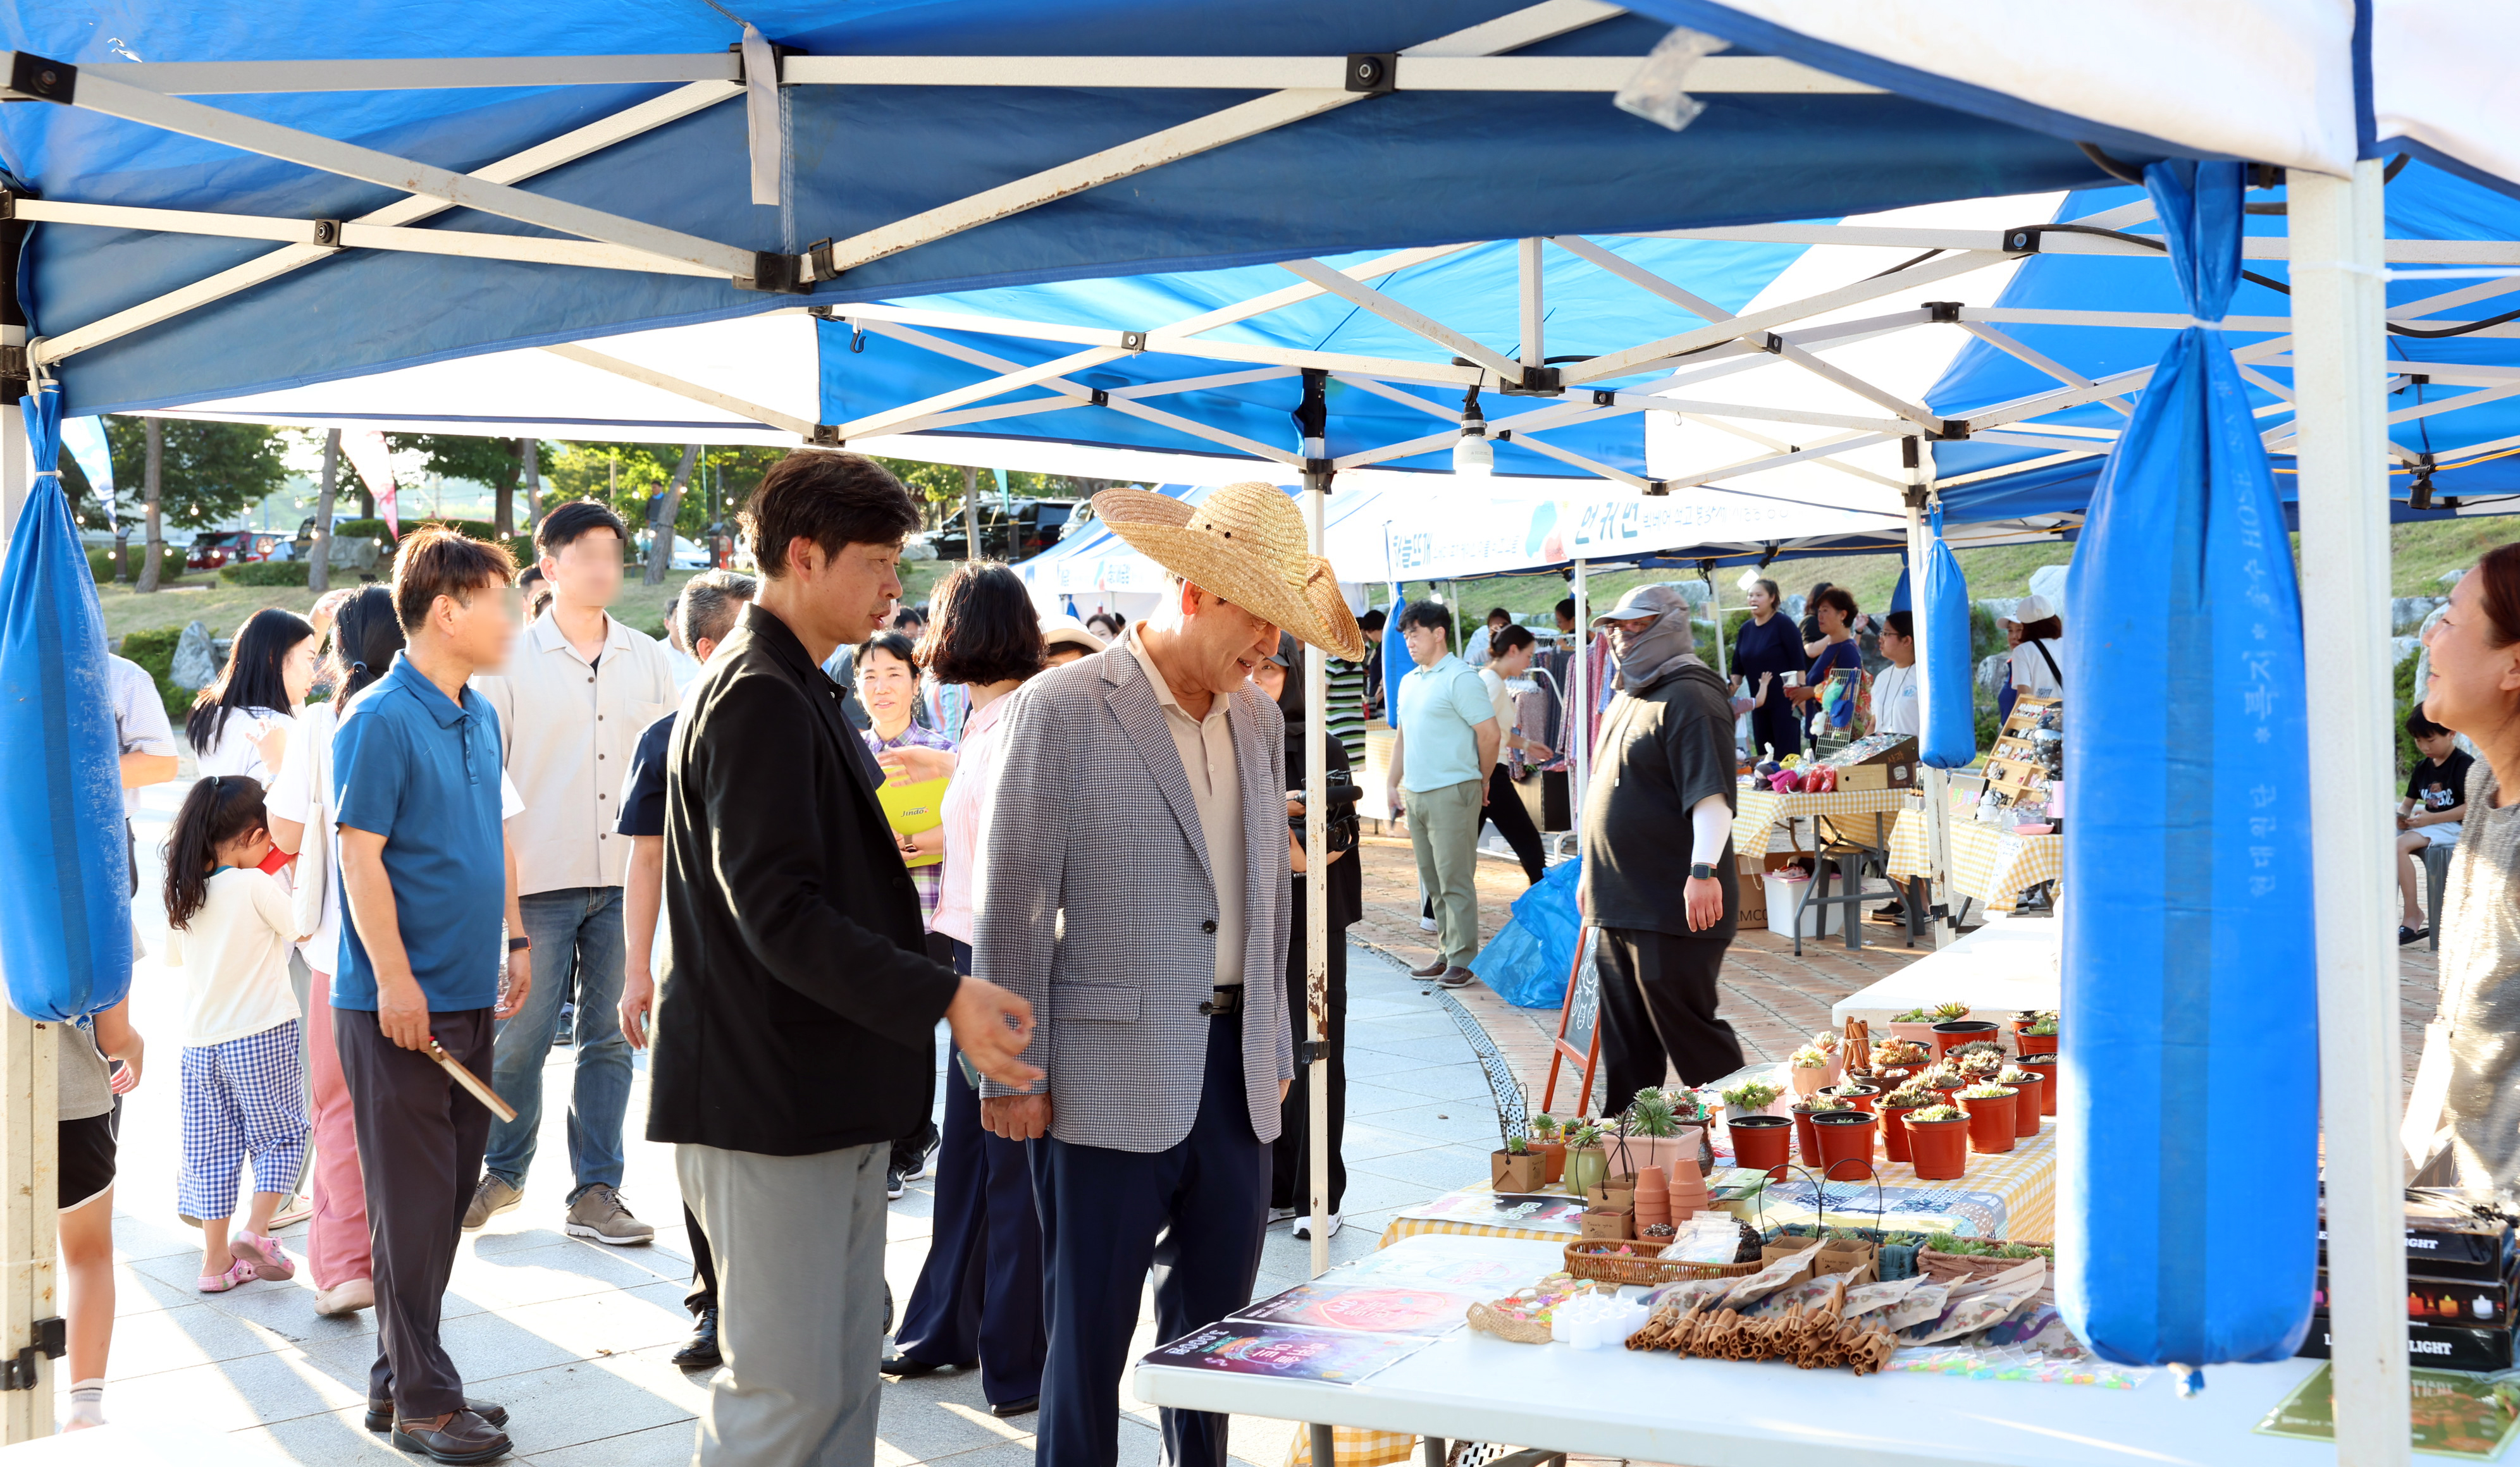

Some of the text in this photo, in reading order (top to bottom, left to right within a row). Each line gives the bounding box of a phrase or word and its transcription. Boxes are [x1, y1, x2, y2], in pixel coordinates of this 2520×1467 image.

[1393, 532, 1433, 568] 하늘뜨개
[2419, 789, 2454, 806] MSIC
[901, 809, 924, 818] Jindo
[2404, 1237, 2438, 1249] IGHT
[1164, 1330, 1230, 1355] 3,000원
[2409, 1340, 2452, 1356] LIGHT
[1252, 1344, 1294, 1358] 아트
